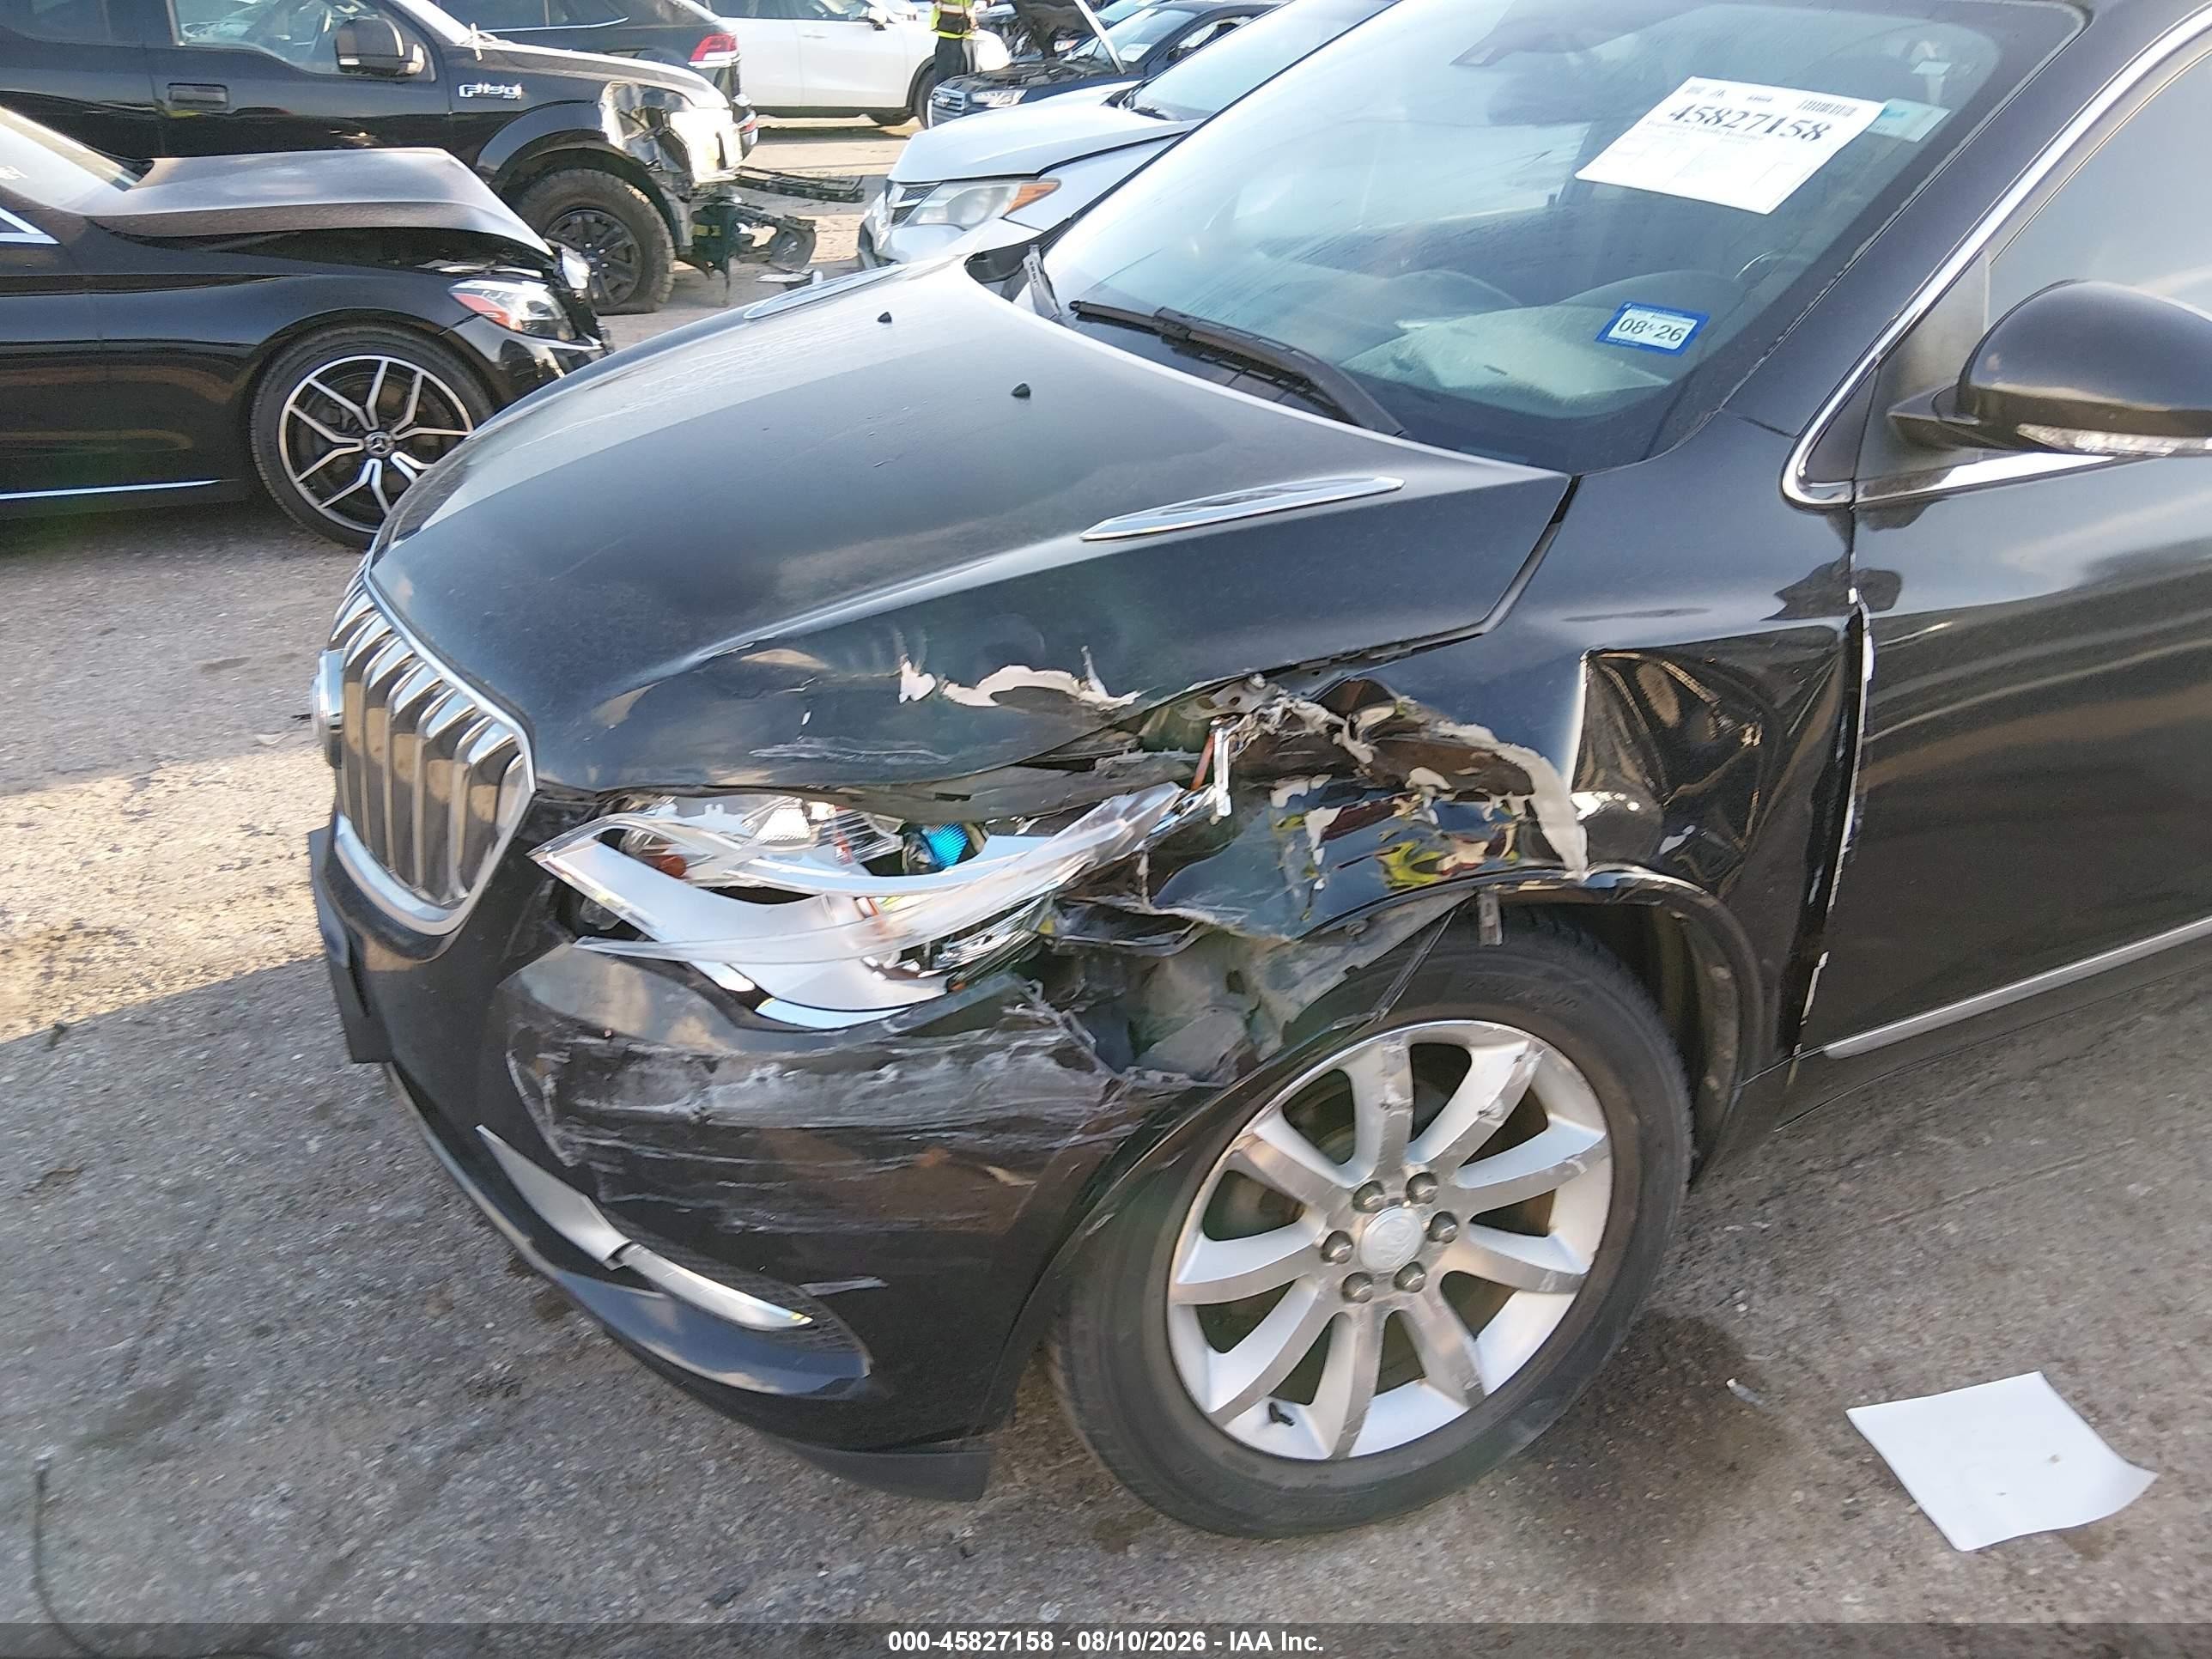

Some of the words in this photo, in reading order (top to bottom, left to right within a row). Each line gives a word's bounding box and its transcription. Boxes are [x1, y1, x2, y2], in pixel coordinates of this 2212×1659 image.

[1668, 103, 1832, 142] 45827158
[1619, 318, 1648, 334] 08
[1654, 325, 1686, 342] 26
